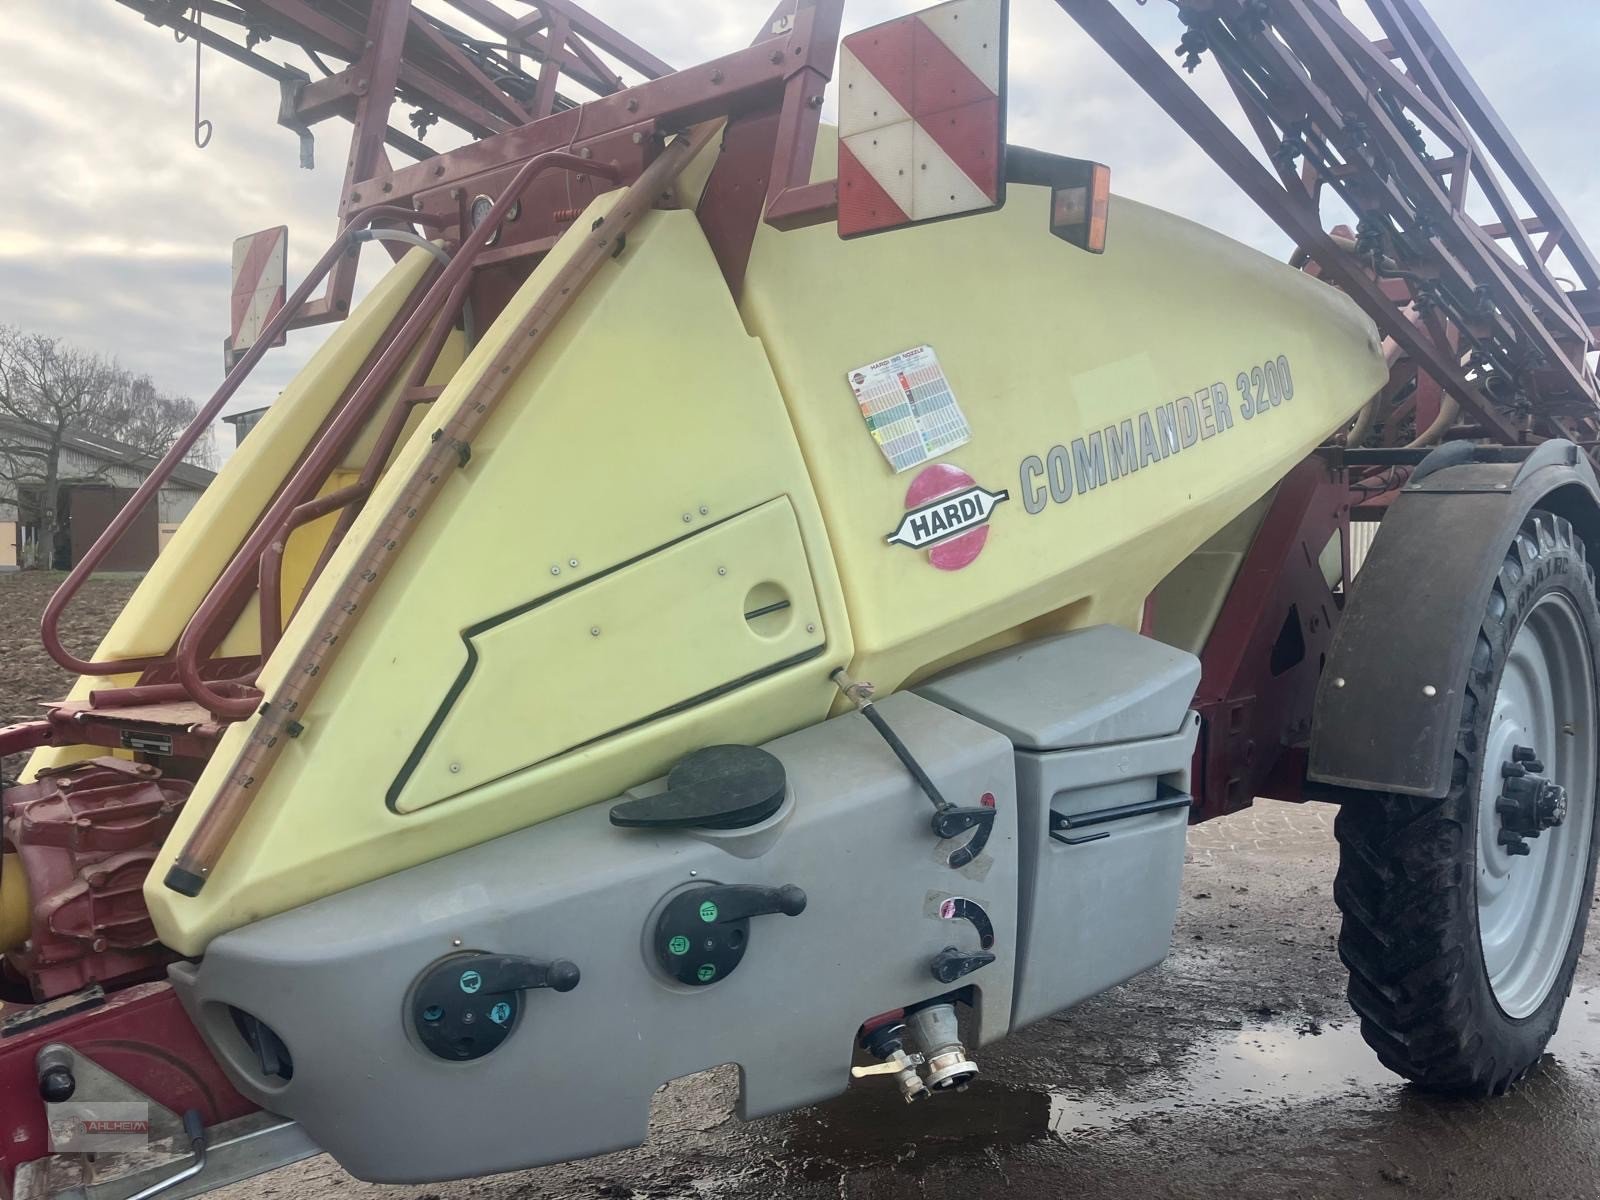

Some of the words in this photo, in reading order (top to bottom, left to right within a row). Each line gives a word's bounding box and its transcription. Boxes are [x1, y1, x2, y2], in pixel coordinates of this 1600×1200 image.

[902, 348, 924, 358] NOZZLE
[1020, 382, 1234, 515] COMMANDER
[1236, 354, 1295, 420] 3200
[909, 494, 985, 542] HARDI
[361, 569, 377, 583] 20
[342, 601, 358, 615] 22
[322, 631, 339, 646] 24
[303, 663, 320, 677] 26
[282, 698, 298, 713] 28
[237, 774, 255, 789] 32
